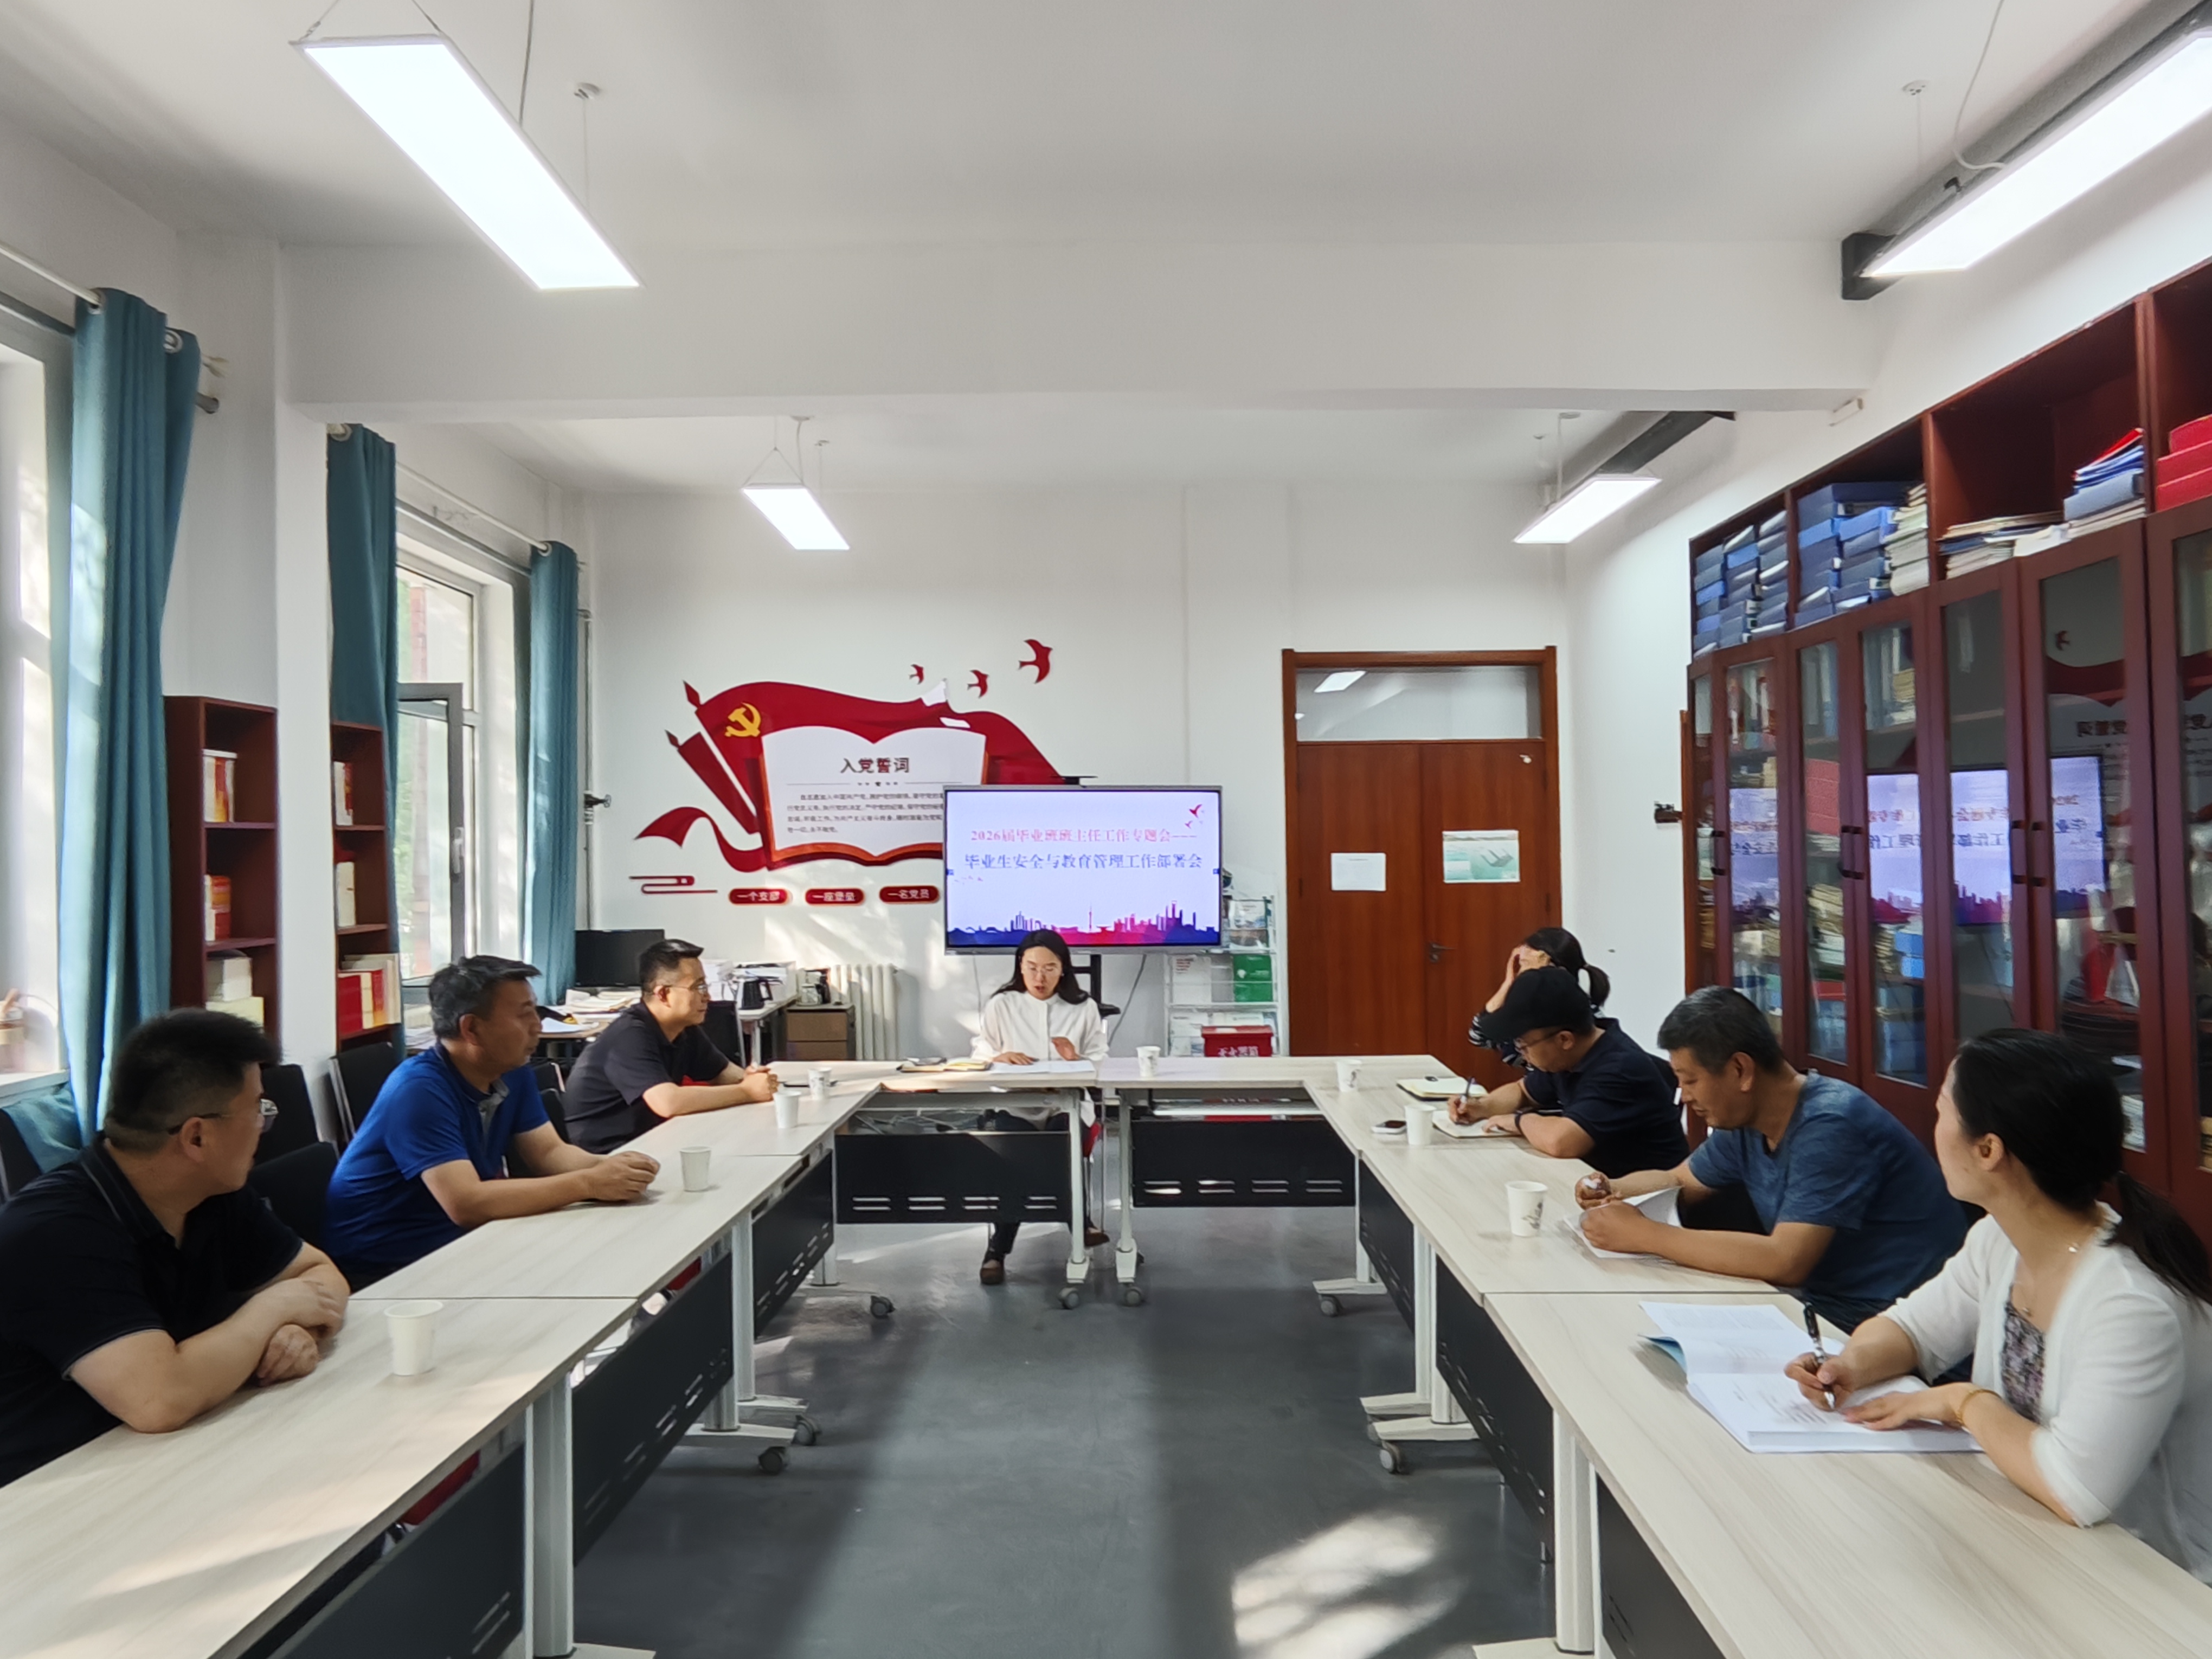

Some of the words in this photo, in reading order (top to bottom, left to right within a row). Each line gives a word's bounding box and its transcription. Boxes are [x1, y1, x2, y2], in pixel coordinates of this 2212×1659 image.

[840, 757, 909, 773] 入党誓词
[965, 853, 1202, 869] 毕业生安全与教育管理工作部署会
[737, 891, 780, 902] 一个支部
[887, 889, 929, 899] 一名党员
